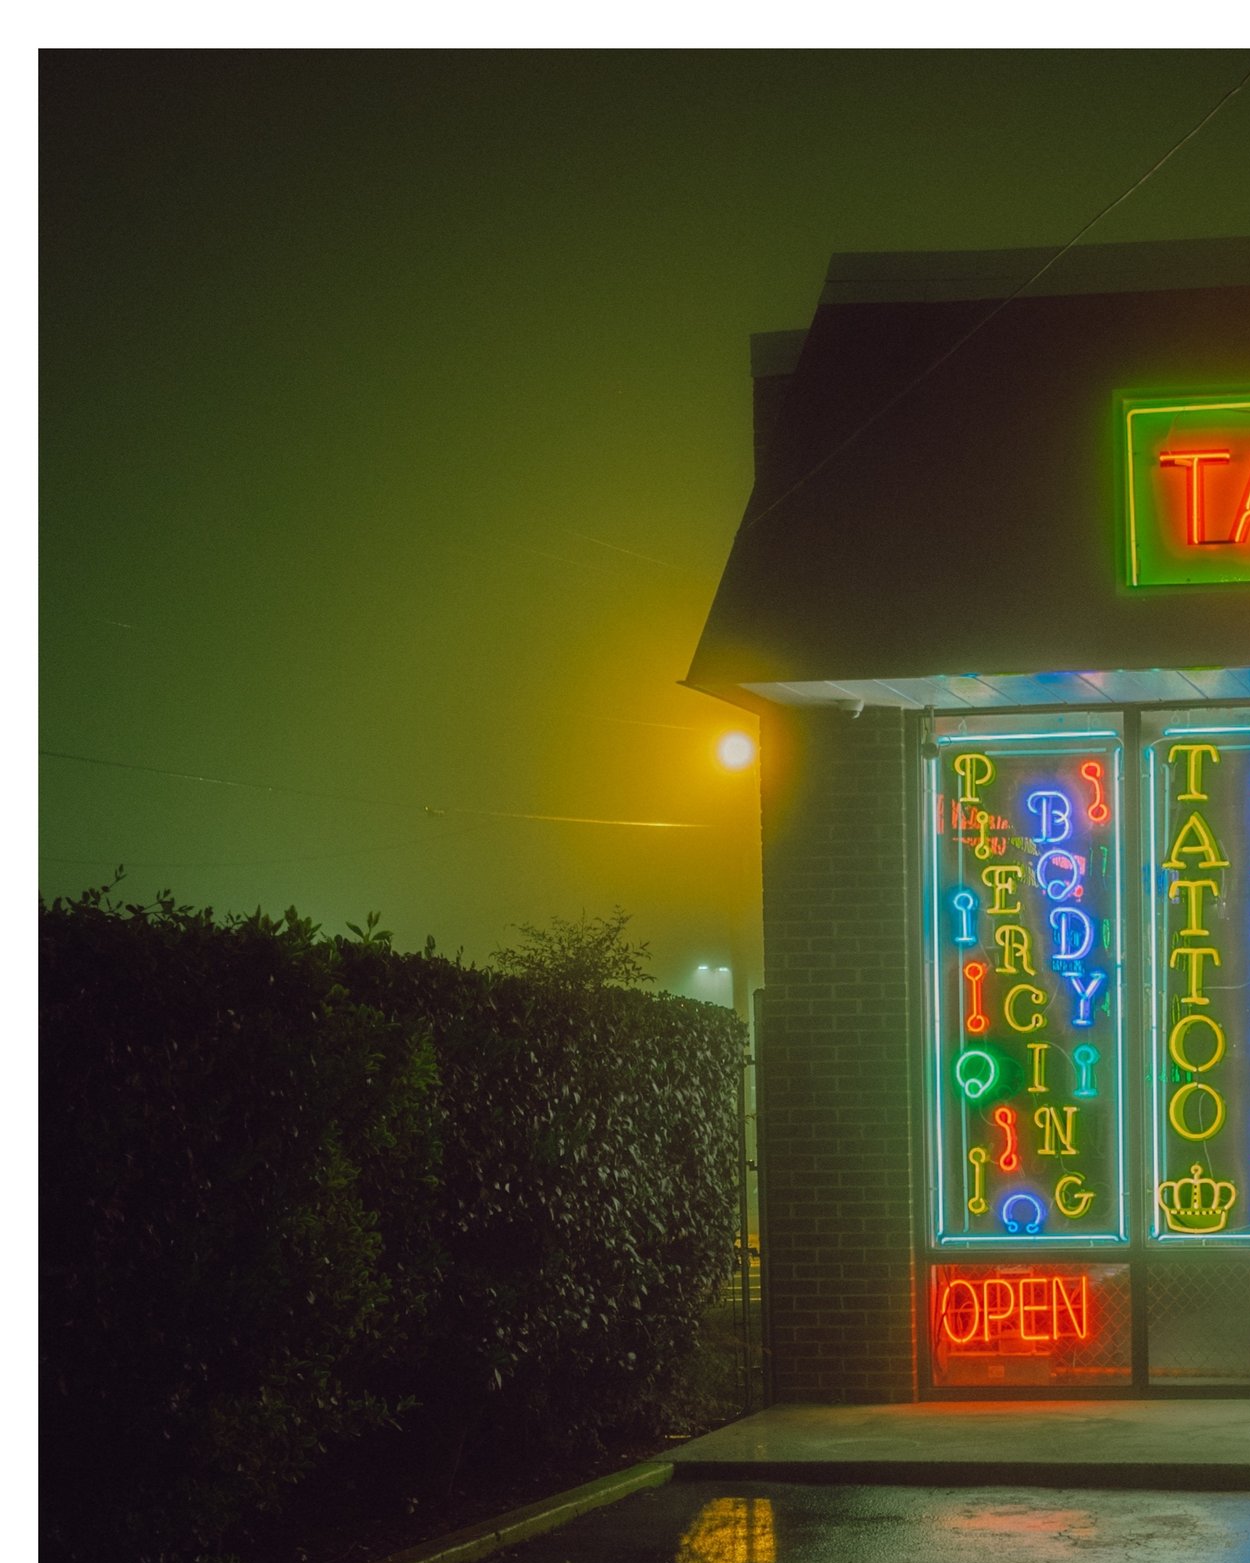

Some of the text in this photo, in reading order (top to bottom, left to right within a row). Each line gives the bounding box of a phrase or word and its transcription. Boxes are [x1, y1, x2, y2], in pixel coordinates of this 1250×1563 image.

[1026, 791, 1106, 1027] BODY
[1162, 744, 1230, 1141] TATTOO
[942, 1275, 1089, 1342] OPEN
